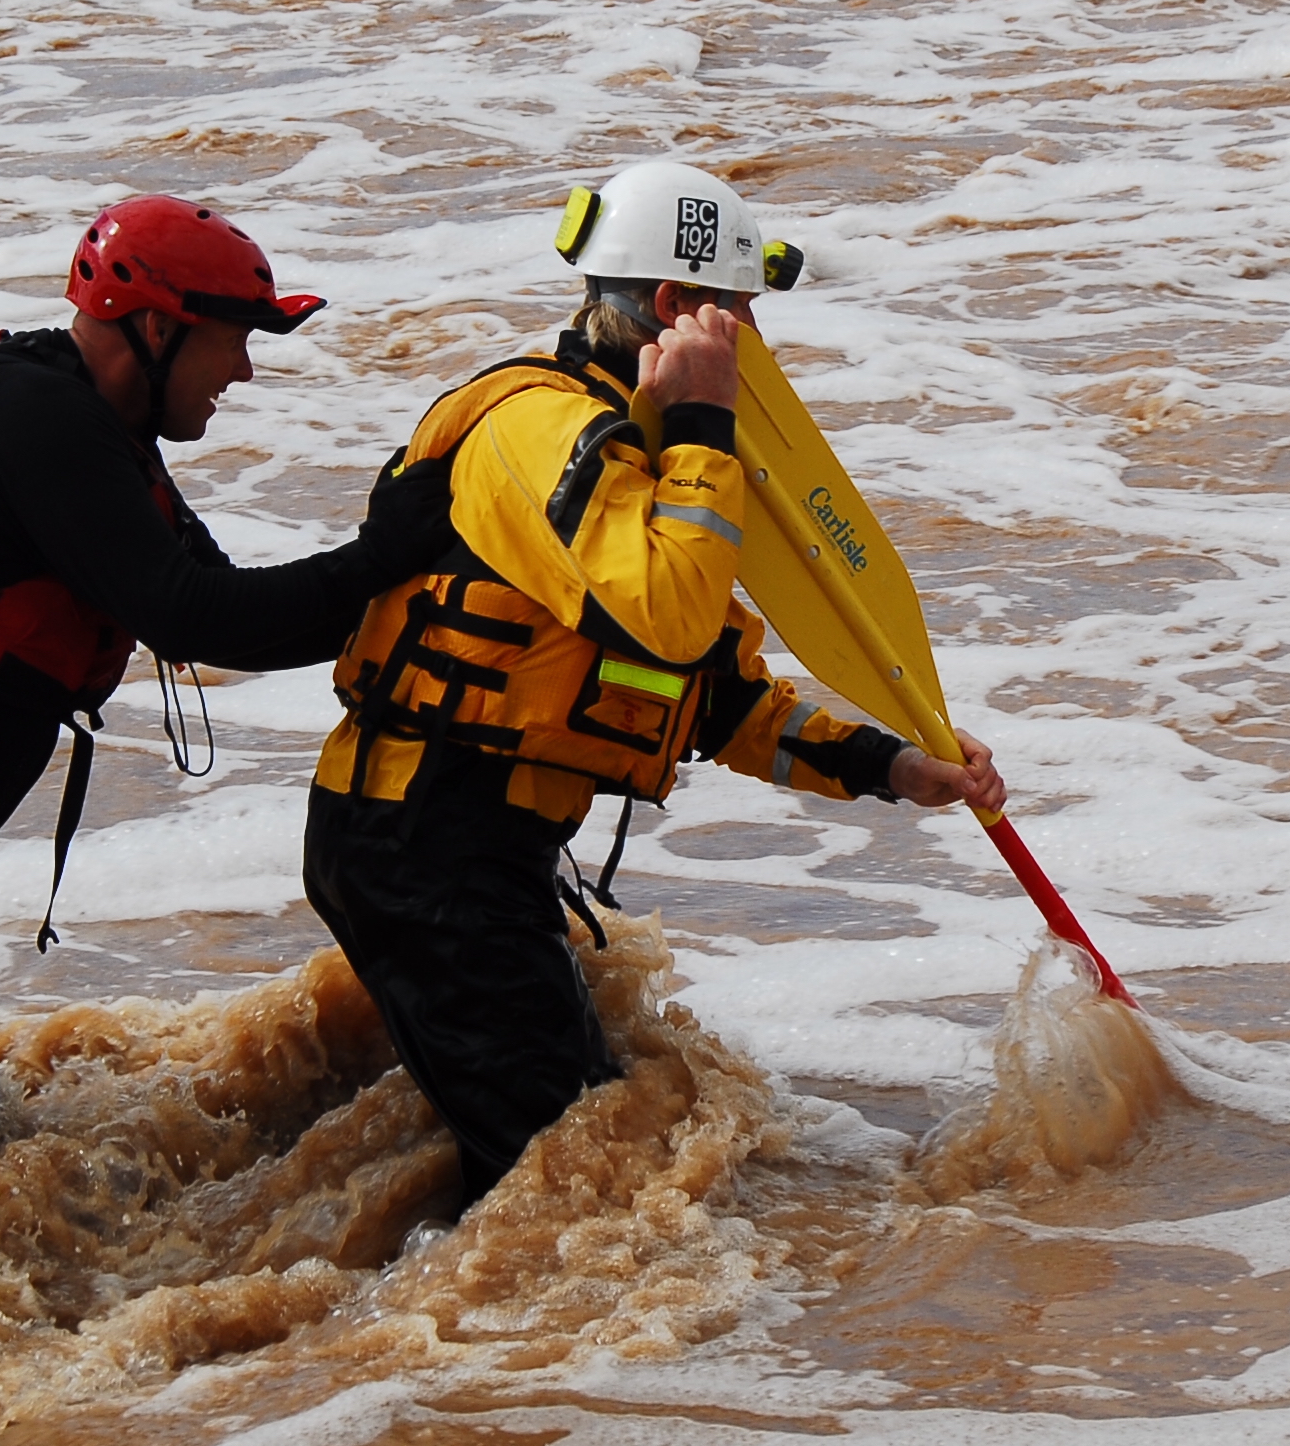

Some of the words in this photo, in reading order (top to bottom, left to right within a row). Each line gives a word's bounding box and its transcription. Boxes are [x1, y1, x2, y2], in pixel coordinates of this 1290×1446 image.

[682, 199, 715, 226] BC
[679, 225, 715, 258] 192
[809, 487, 868, 572] Carlisle
